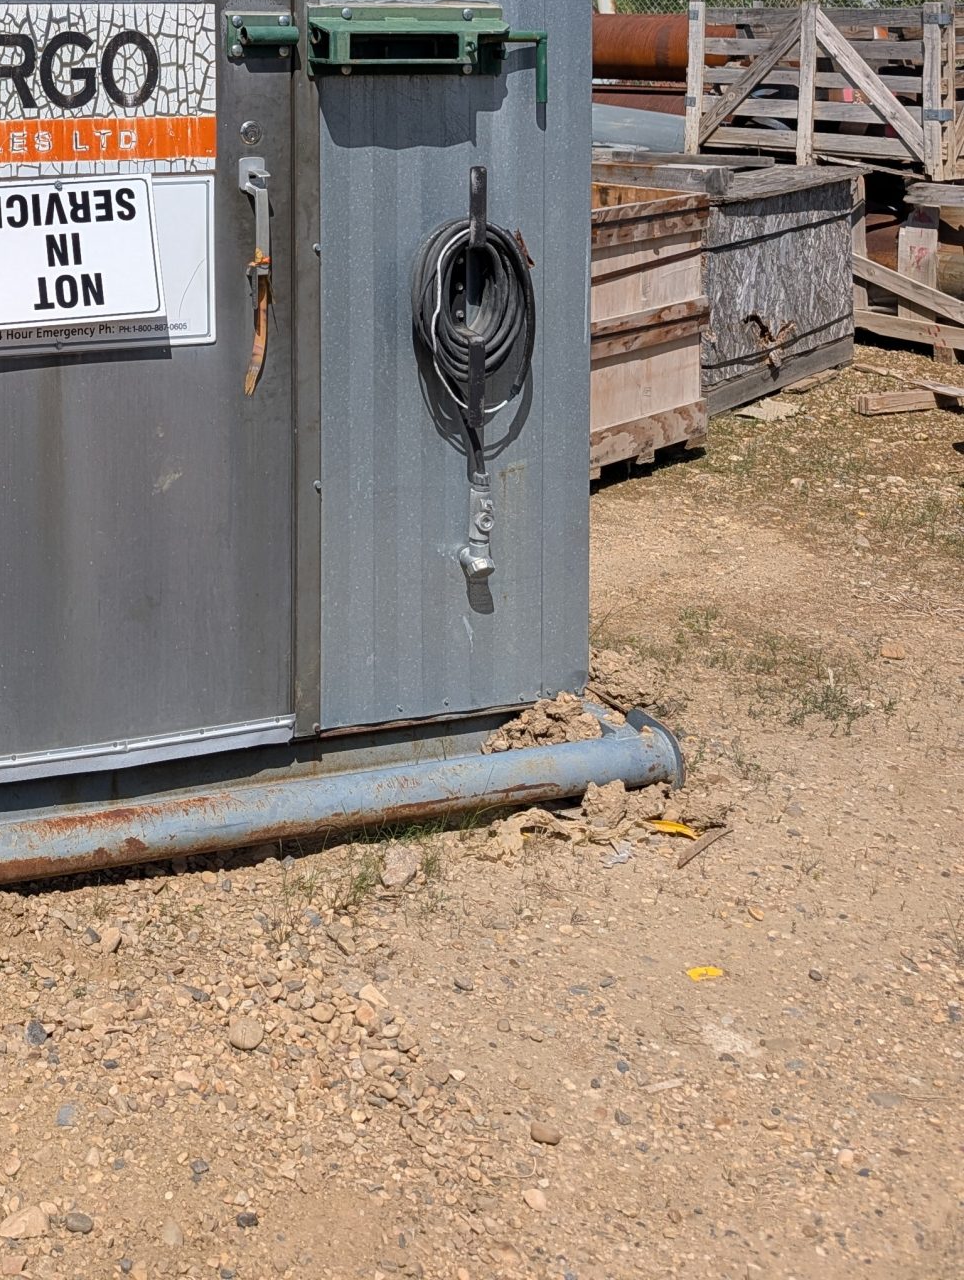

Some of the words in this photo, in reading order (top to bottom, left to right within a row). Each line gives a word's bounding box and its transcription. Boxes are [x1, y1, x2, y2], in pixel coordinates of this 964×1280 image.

[72, 128, 138, 152] LTD
[46, 232, 82, 268] IN
[34, 272, 105, 310] NOT
[6, 328, 32, 340] Hour
[36, 324, 96, 339] Emergency
[98, 322, 115, 335] Ph:
